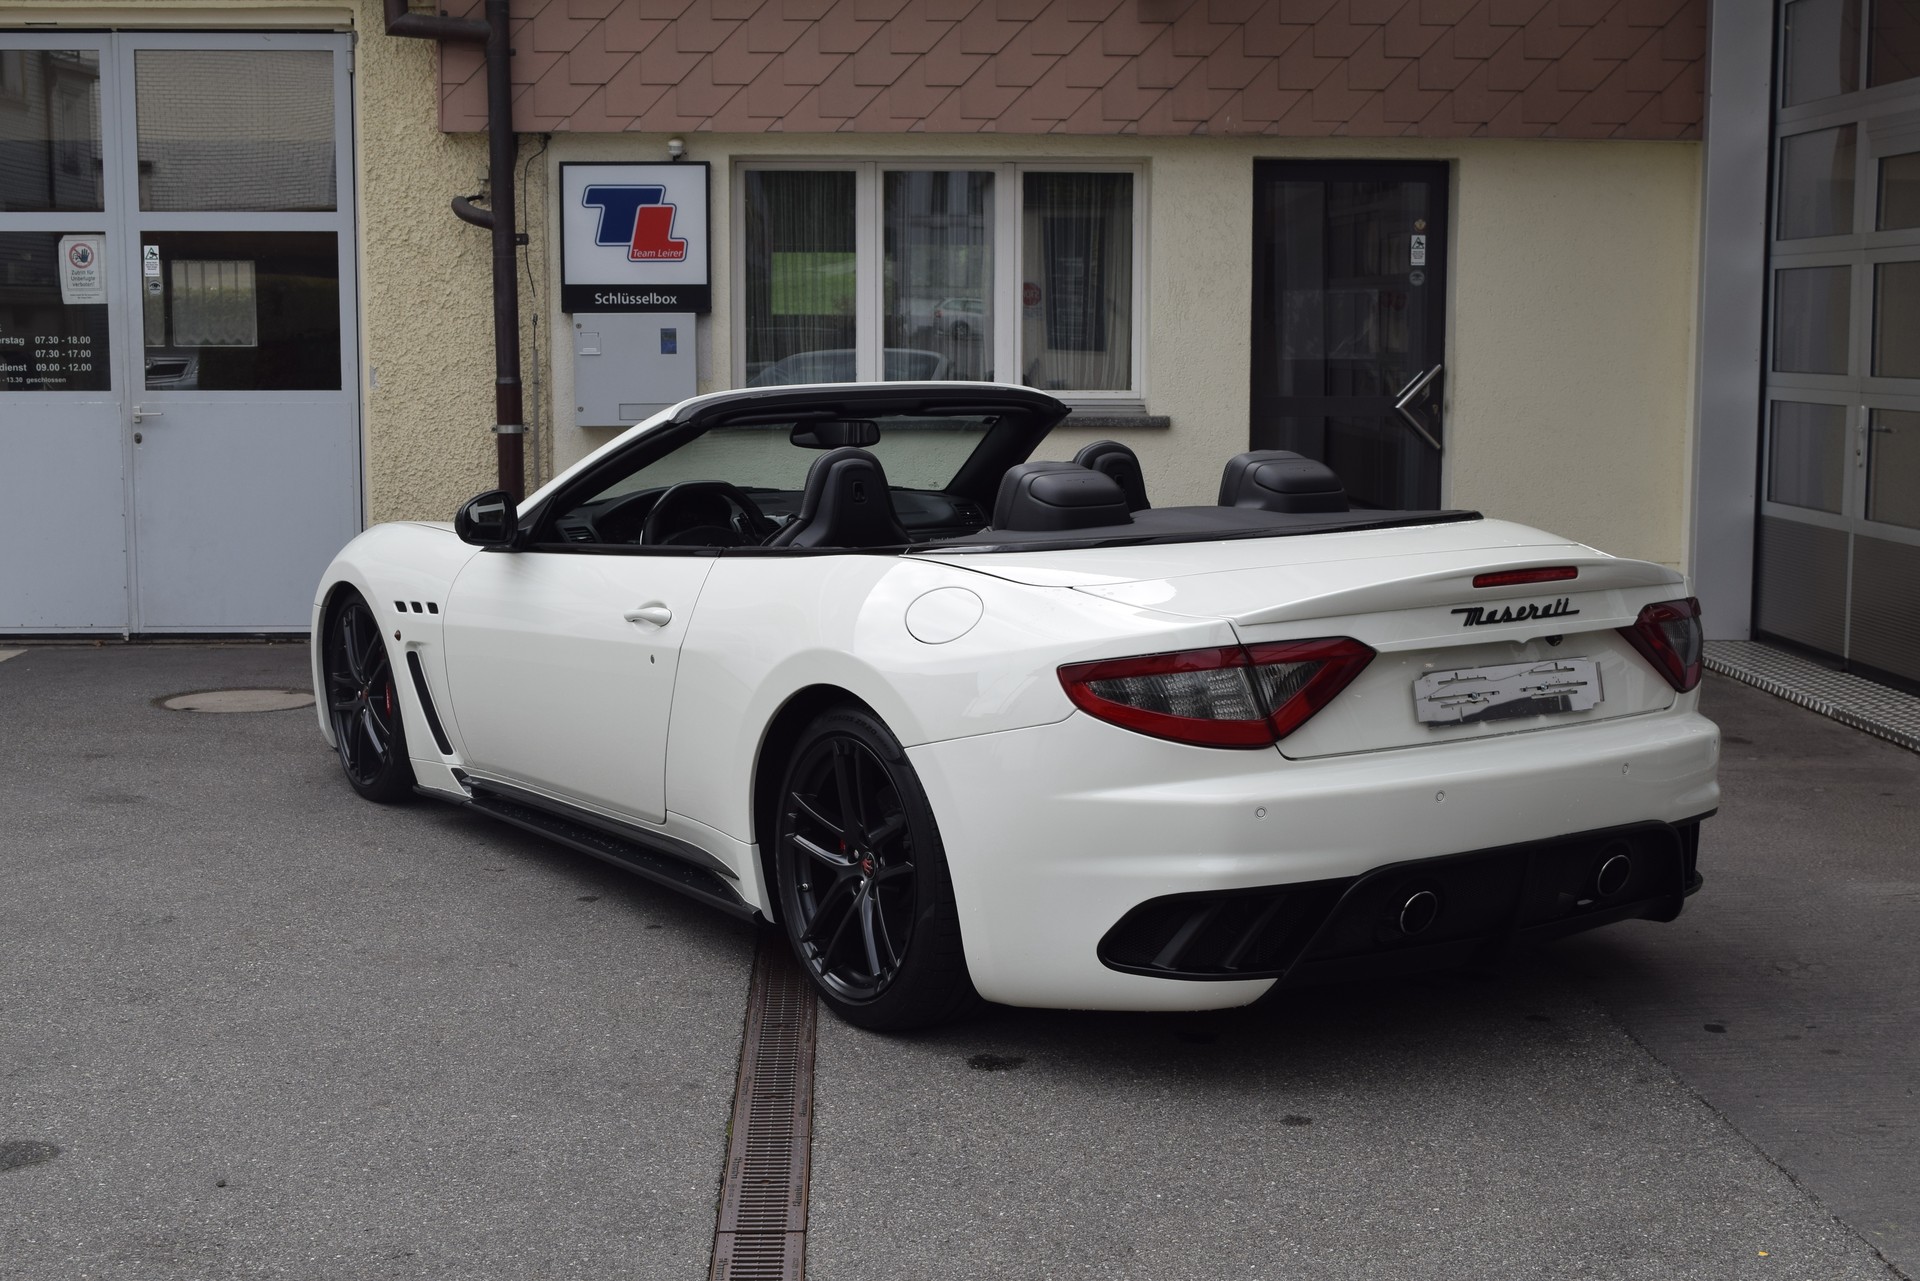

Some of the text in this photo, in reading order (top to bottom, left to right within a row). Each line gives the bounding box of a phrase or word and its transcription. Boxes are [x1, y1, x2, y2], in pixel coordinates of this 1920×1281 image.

[582, 185, 688, 262] TL
[633, 249, 682, 258] Team Leirer
[594, 293, 677, 304] Schlüsselbox
[34, 336, 59, 344] 07.30
[67, 336, 91, 344] 18.00
[35, 349, 60, 358] 07.30
[67, 349, 92, 358] 17.00
[36, 363, 60, 372] 09.00
[68, 363, 92, 372] 12.00
[1450, 597, 1580, 627] Maserati
